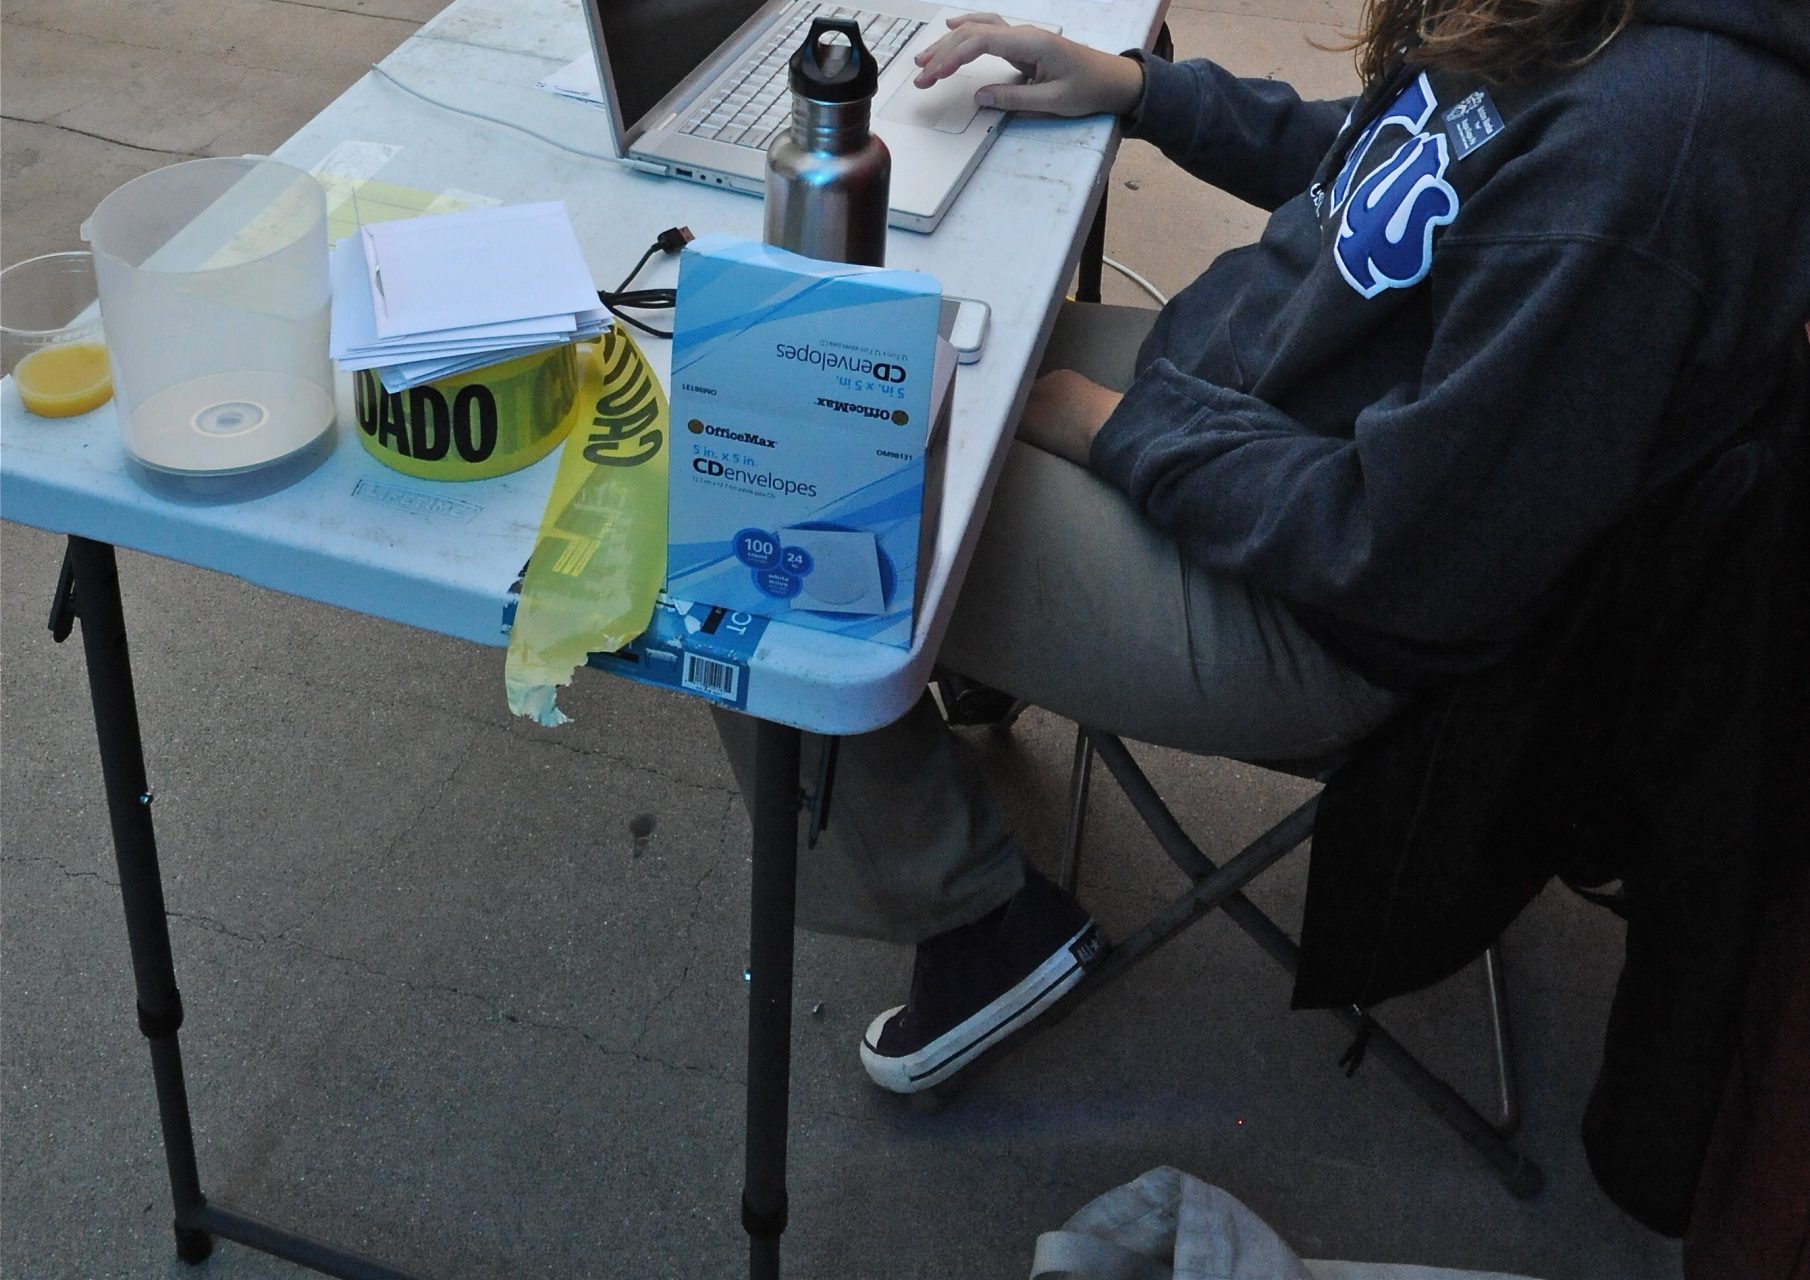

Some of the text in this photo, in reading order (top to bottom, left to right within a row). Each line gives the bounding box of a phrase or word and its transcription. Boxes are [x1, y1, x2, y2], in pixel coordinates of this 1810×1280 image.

[817, 396, 890, 421] OfficeMax
[705, 424, 777, 449] OfficeMax
[693, 444, 700, 455] 5
[732, 452, 741, 463] 5
[744, 538, 774, 555] 100
[787, 553, 803, 564] 24
